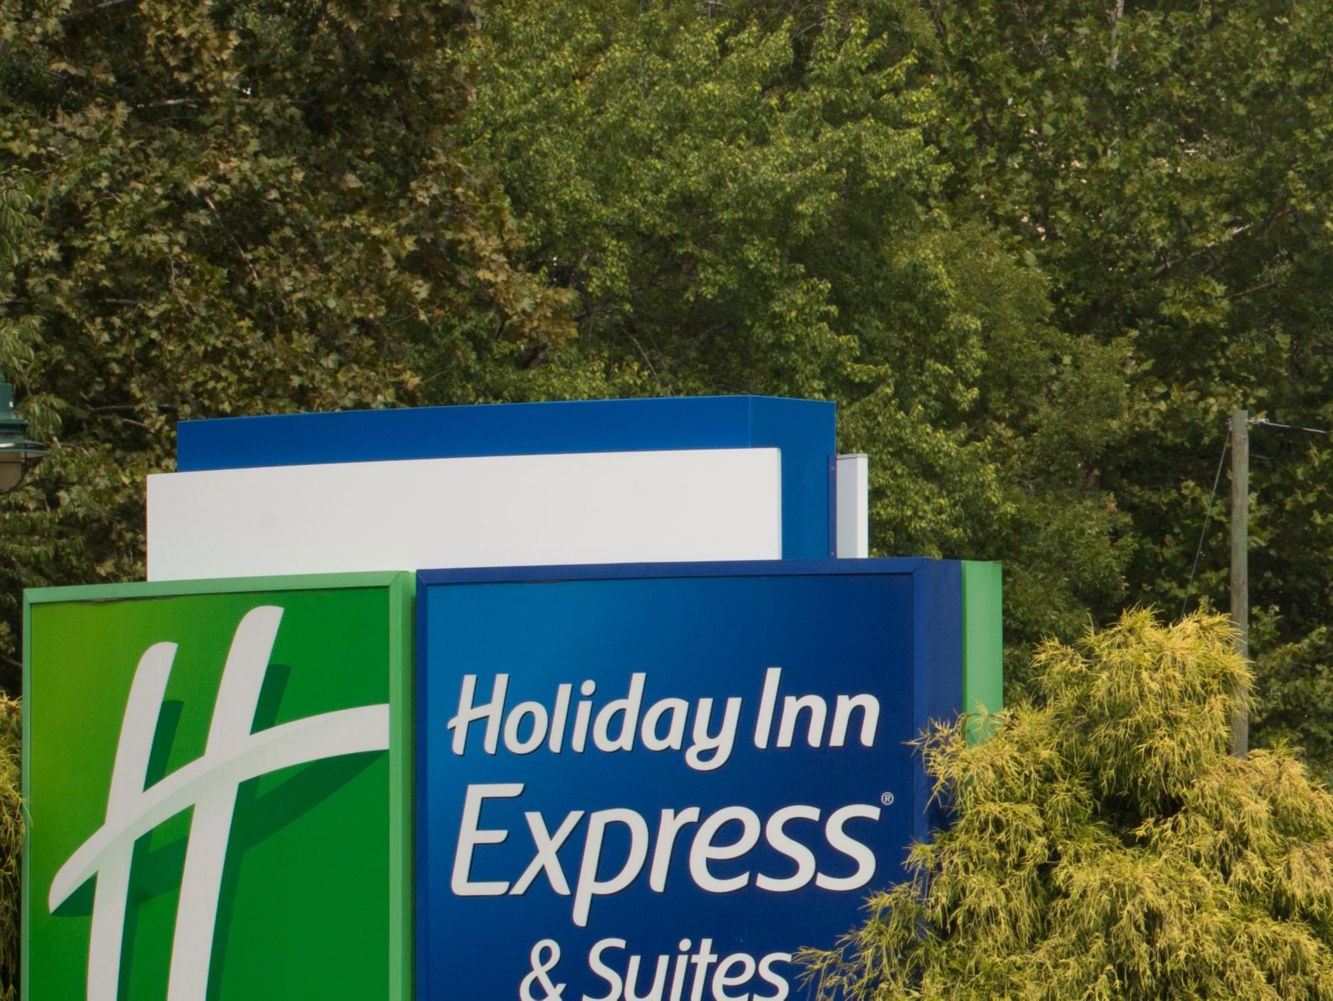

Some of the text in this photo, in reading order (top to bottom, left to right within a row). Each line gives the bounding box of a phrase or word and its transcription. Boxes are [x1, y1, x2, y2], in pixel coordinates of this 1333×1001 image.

[446, 666, 881, 772] Holiday Inn
[519, 937, 792, 1001] & Suites
